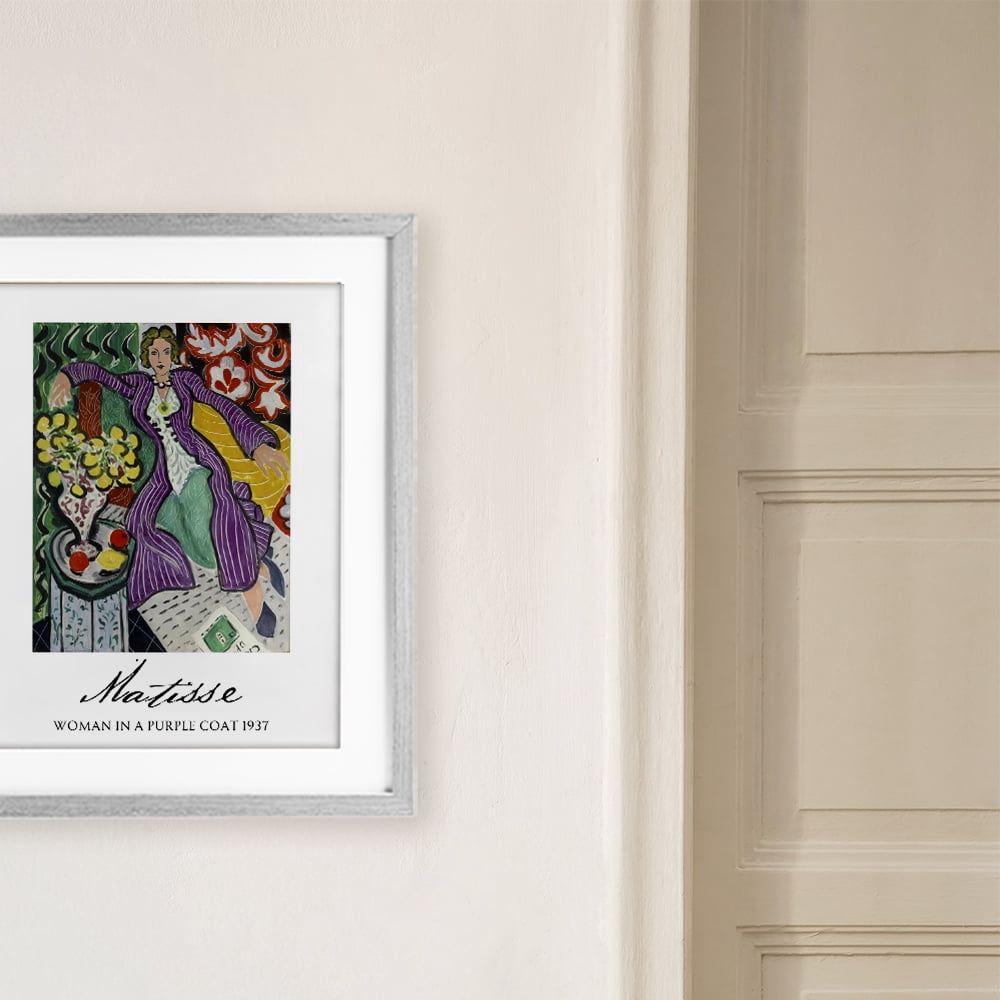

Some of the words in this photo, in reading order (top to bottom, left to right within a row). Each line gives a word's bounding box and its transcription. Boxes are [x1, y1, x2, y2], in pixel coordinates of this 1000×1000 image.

[79, 658, 243, 708] Matisse
[53, 719, 111, 732] WOMAN
[115, 719, 130, 732] IN
[133, 719, 144, 732] A
[147, 719, 196, 732] PURPLE
[199, 719, 238, 732] COAT
[242, 719, 269, 732] 1937
